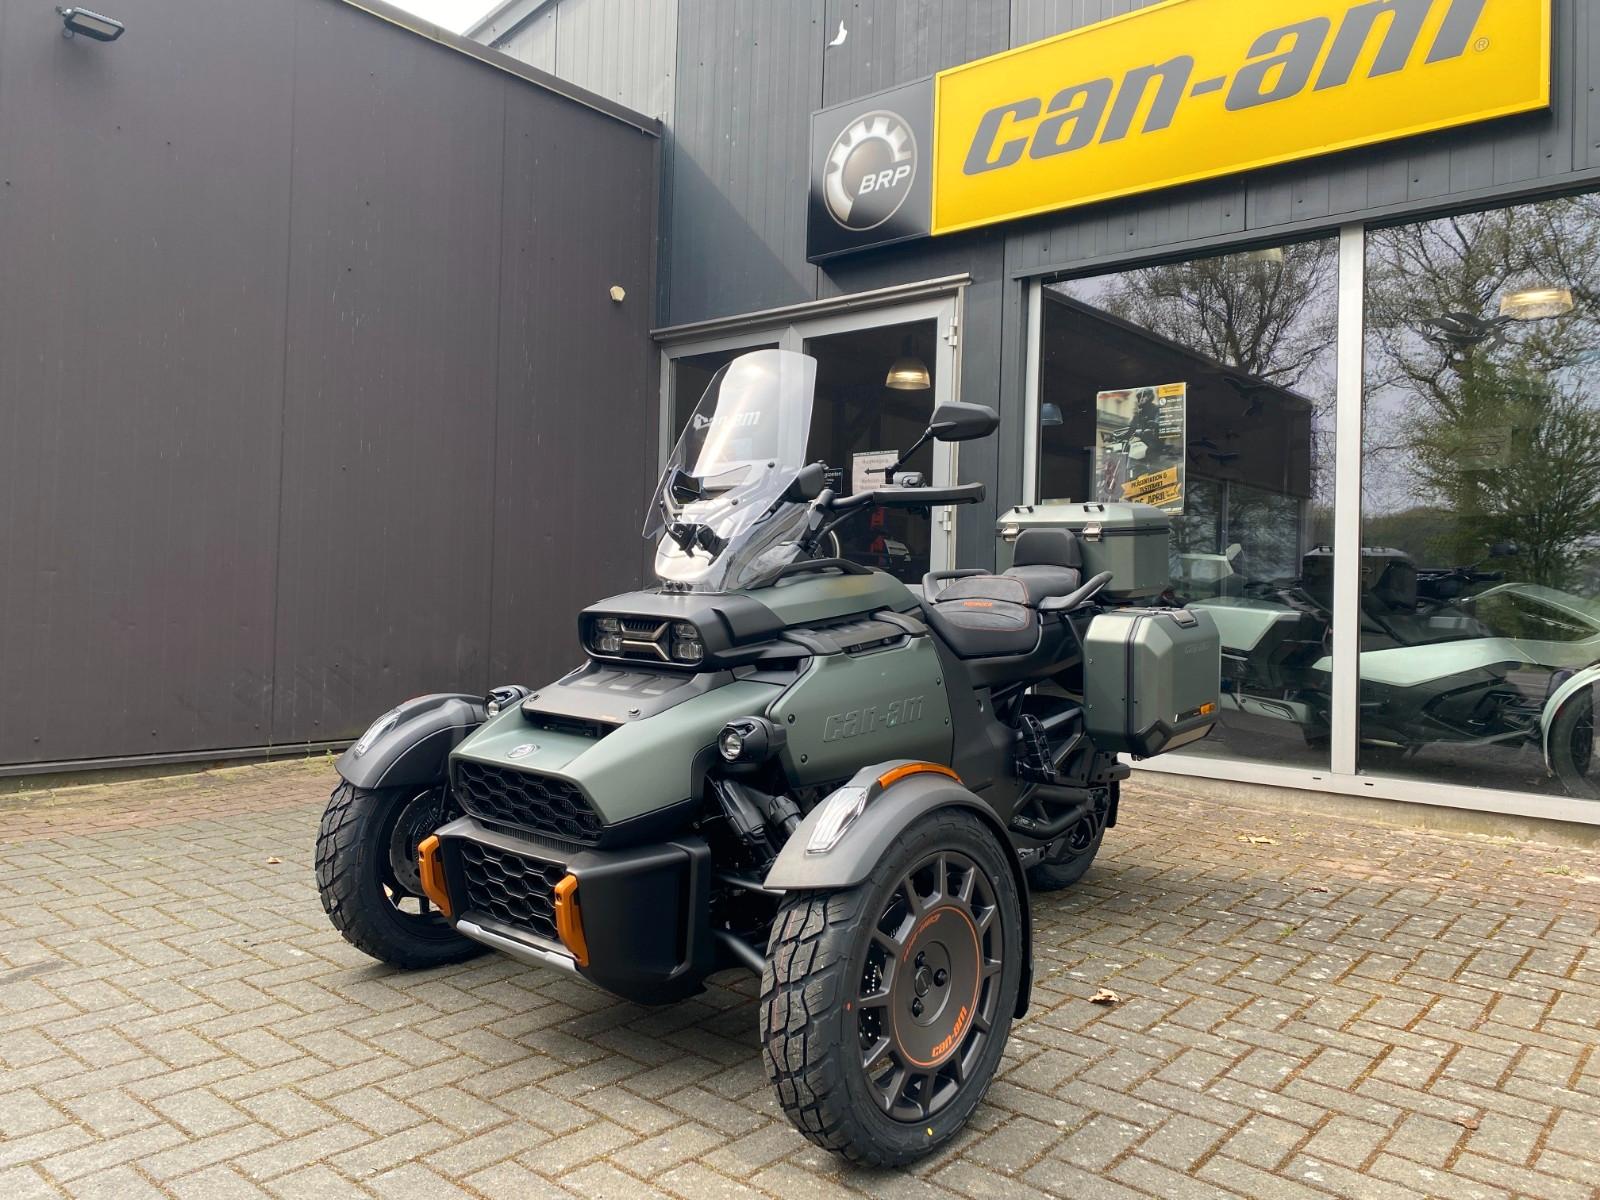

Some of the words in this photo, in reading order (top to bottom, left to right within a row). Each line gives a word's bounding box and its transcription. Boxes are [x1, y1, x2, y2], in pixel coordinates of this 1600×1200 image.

[858, 165, 911, 195] BRP
[823, 695, 924, 743] can-am
[931, 1005, 968, 1058] can-am
